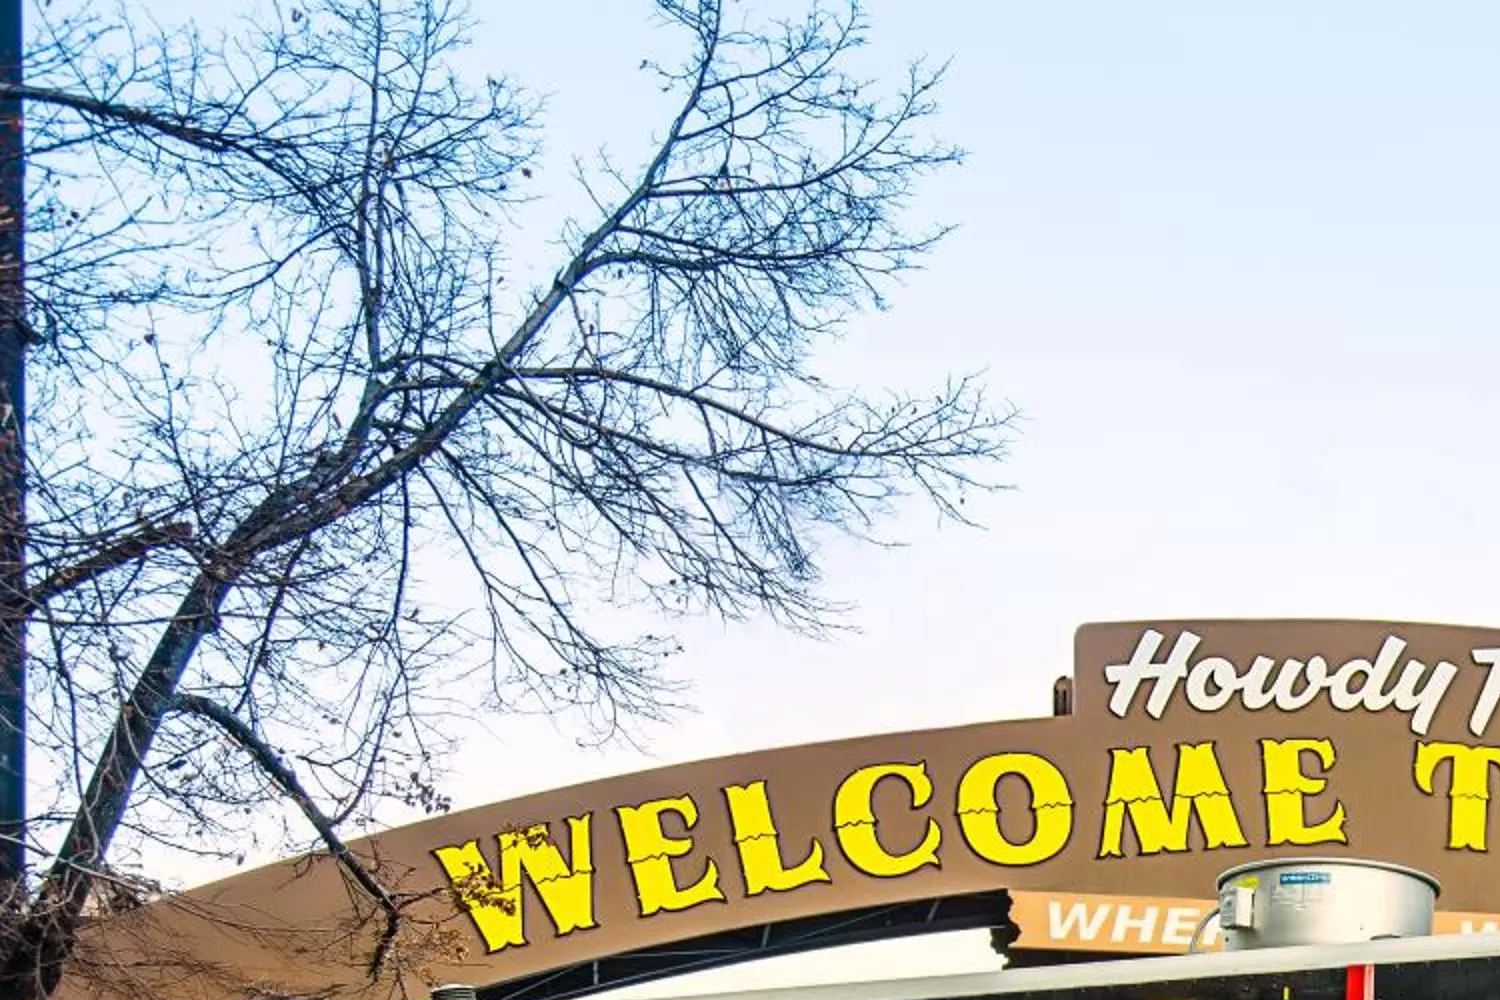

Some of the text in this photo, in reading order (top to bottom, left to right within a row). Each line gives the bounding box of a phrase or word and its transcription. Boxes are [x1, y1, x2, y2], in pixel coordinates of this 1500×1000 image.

[1104, 628, 1458, 736] Howdy
[431, 738, 1349, 954] WELCOME
[1048, 901, 1221, 946] WHE
